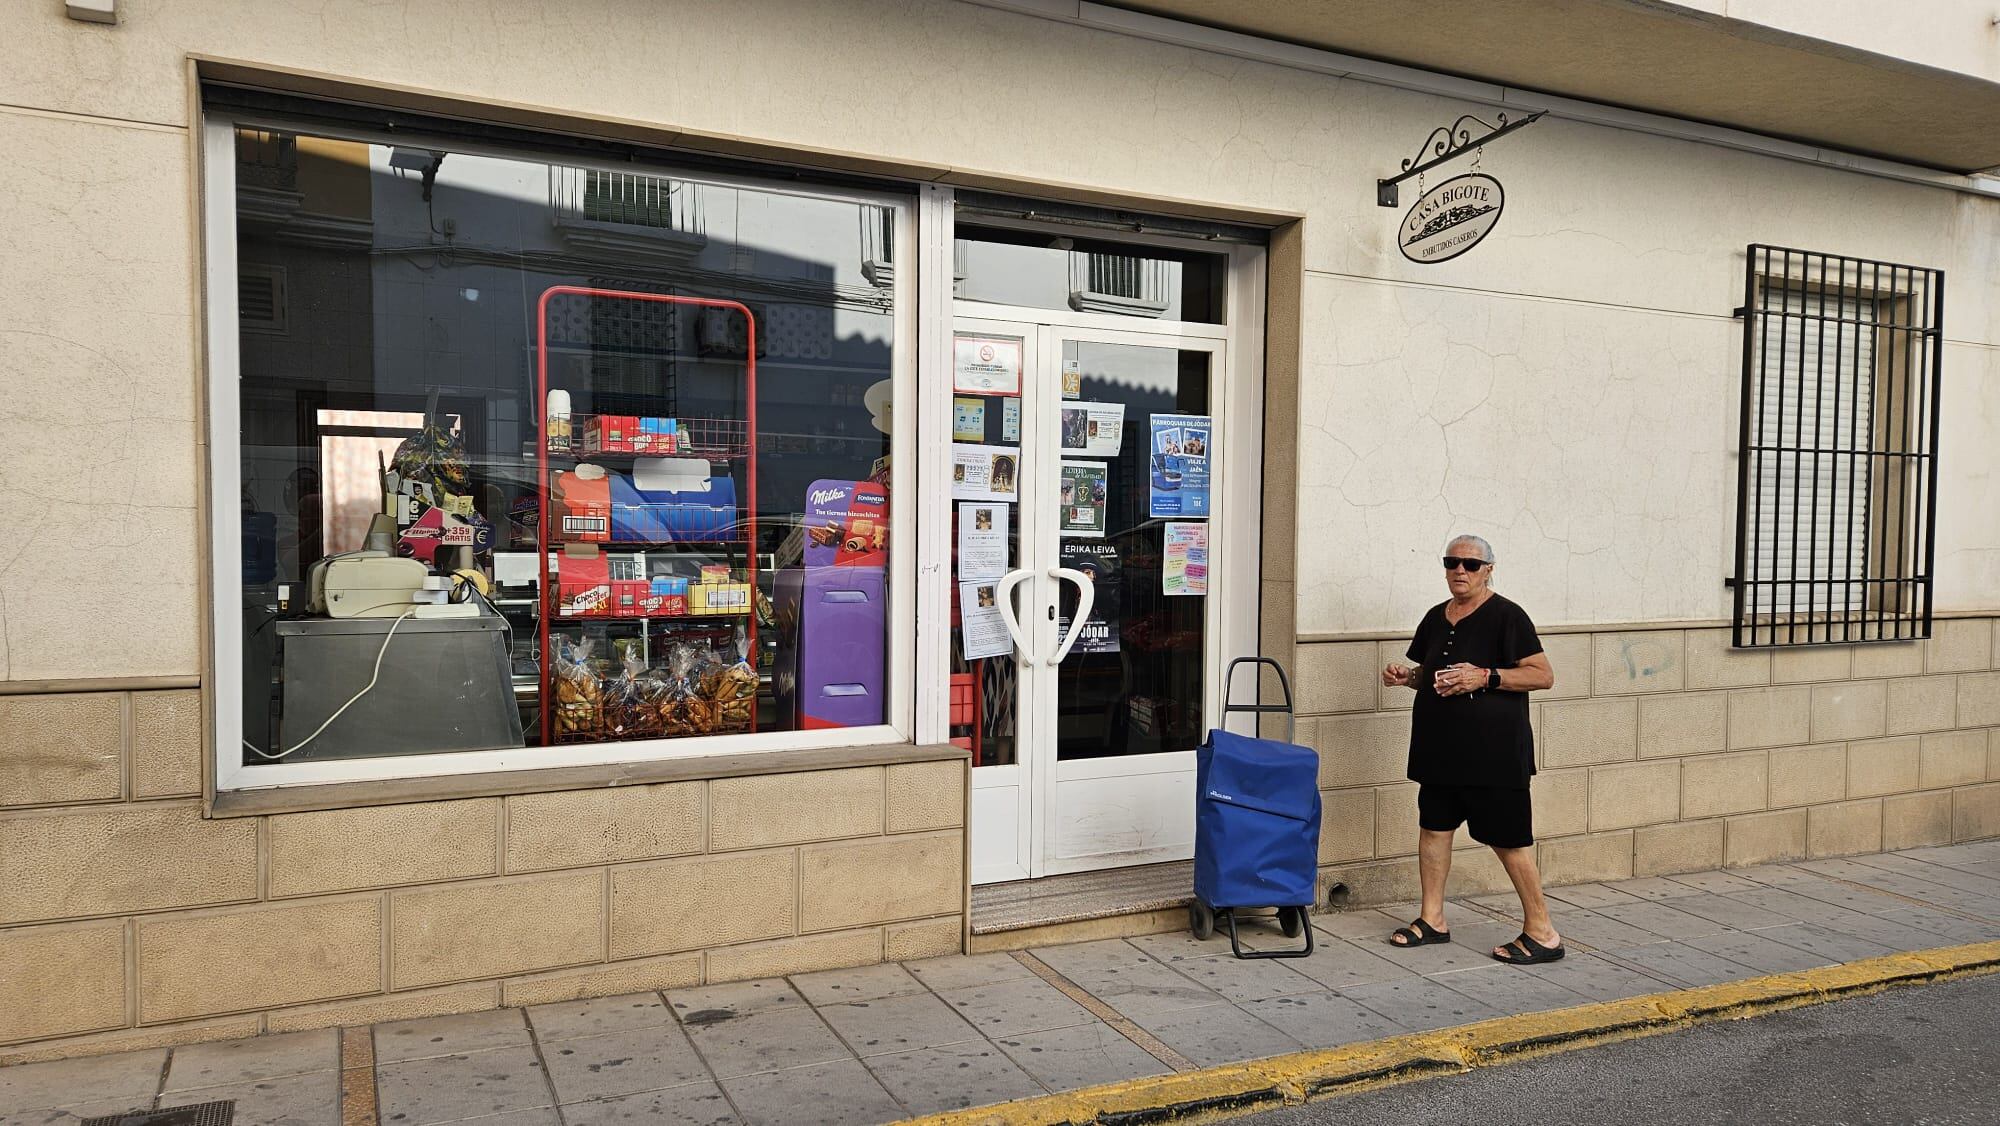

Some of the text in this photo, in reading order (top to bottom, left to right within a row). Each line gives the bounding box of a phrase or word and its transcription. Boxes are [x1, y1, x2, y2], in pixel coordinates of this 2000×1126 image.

[1409, 185, 1490, 231] CASA BIGOTE
[1422, 229, 1478, 257] EMBUTIDOS CASEROS
[810, 488, 846, 505] Milka
[446, 527, 470, 535] +35g
[1065, 545, 1116, 553] ERIKA LEIVA
[576, 590, 598, 604] Choco
[1080, 625, 1109, 638] JÓDAR
